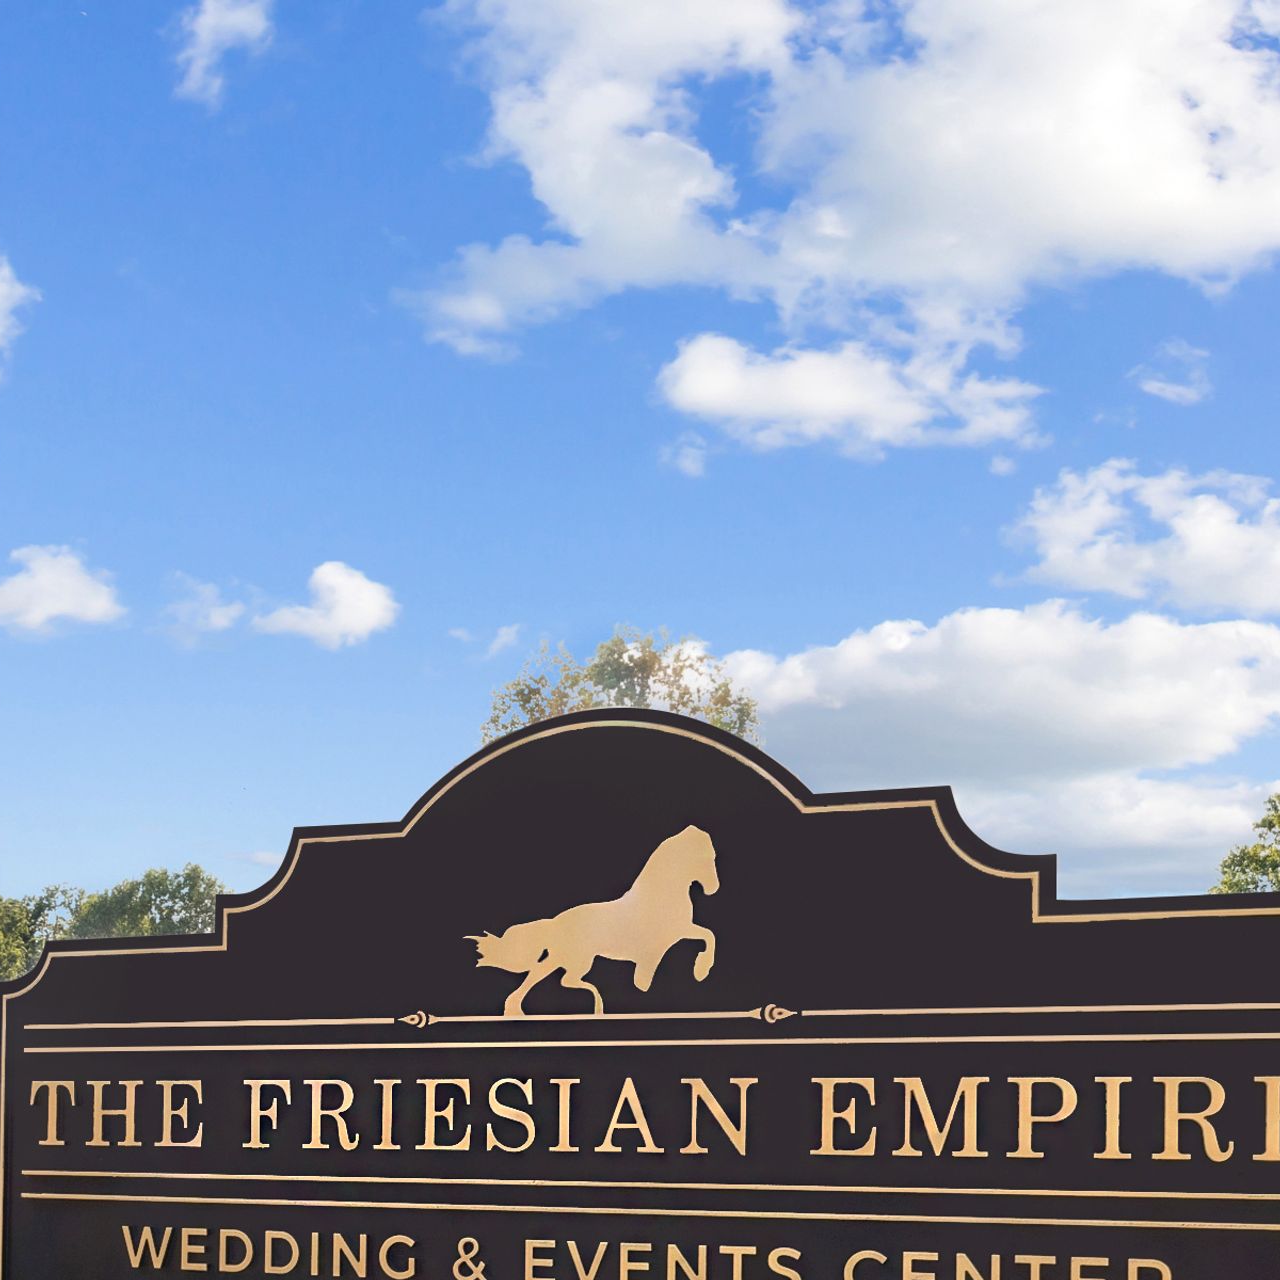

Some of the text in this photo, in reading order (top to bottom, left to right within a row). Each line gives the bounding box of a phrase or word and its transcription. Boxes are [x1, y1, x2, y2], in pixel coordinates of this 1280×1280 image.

[28, 1079, 205, 1148] THE
[240, 1077, 760, 1157] FRIESIAN
[121, 1225, 417, 1280] WEDDING
